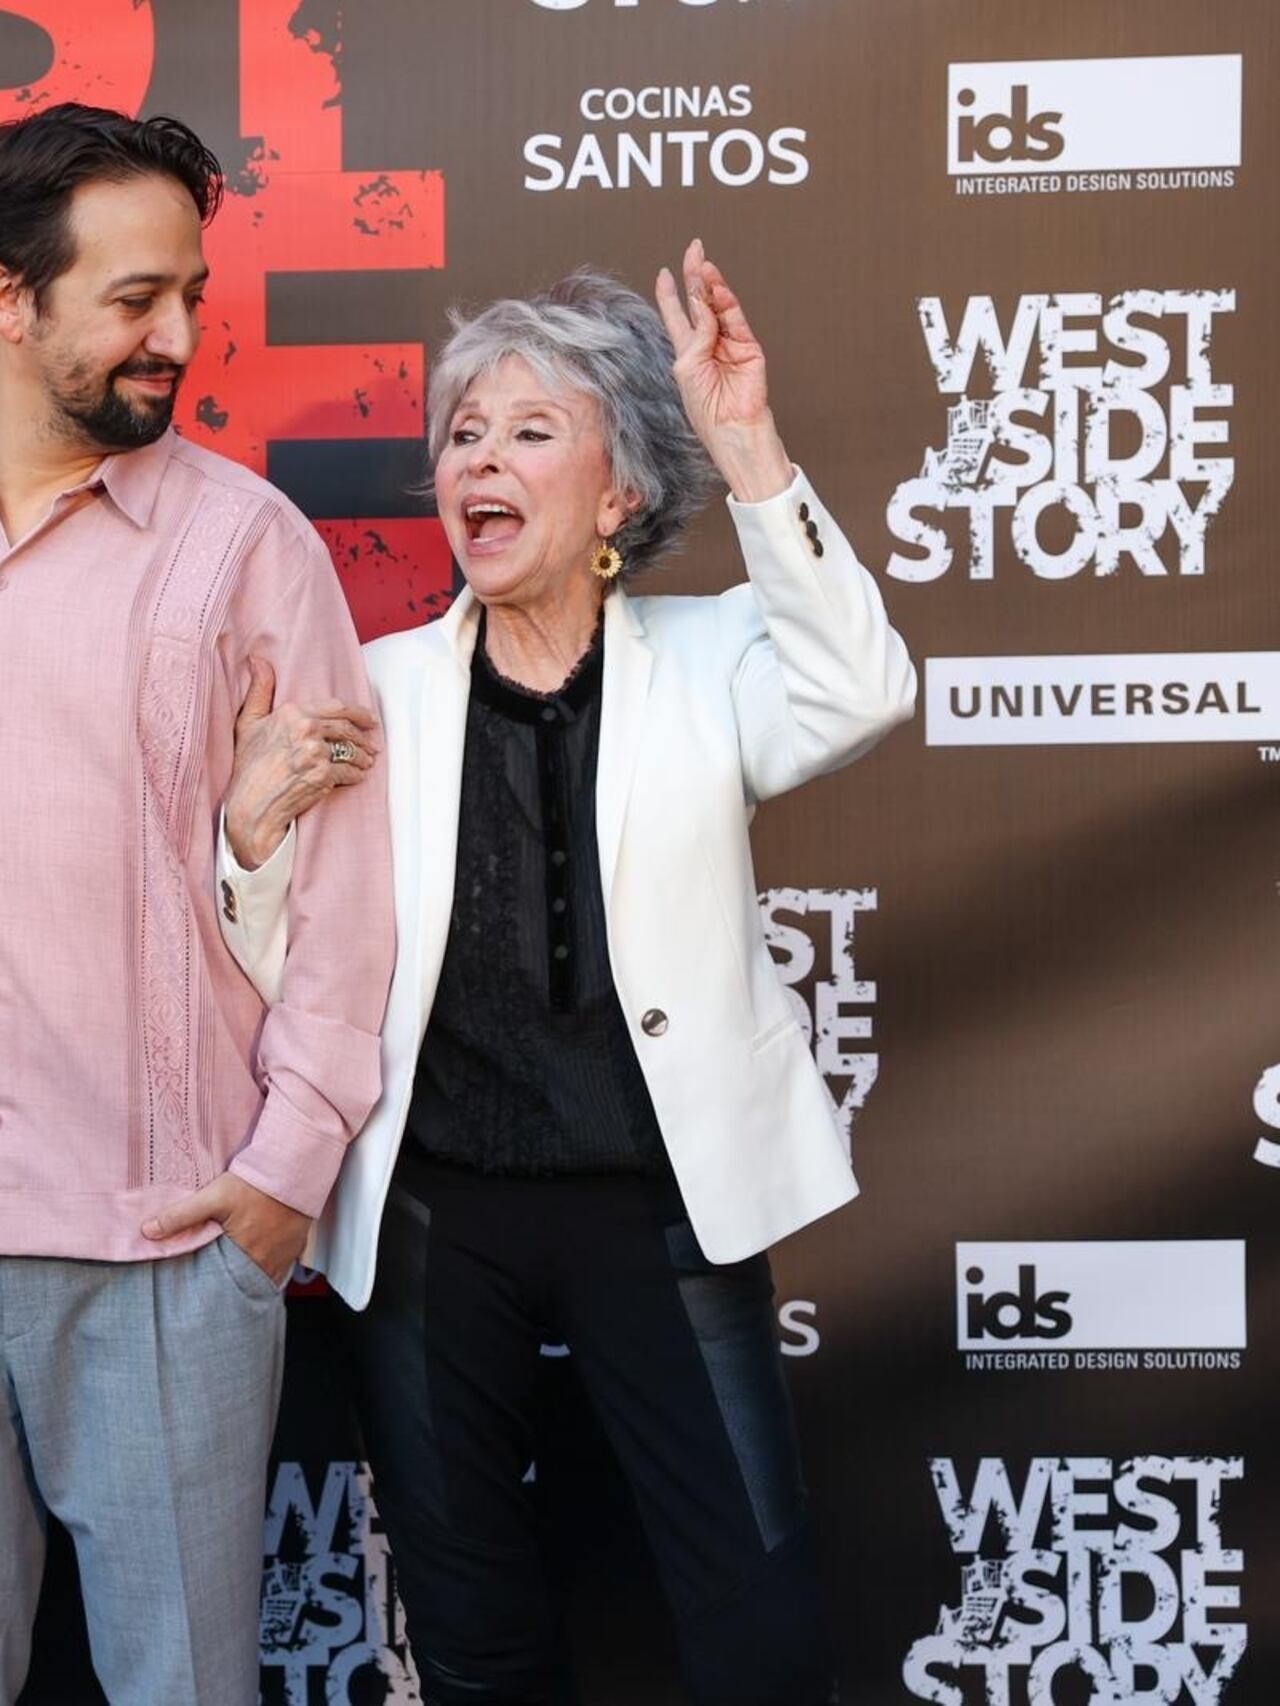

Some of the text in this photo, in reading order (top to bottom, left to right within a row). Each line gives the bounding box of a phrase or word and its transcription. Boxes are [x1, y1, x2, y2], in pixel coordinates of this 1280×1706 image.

[580, 84, 752, 120] COCINAS
[957, 84, 1065, 163] ids
[523, 127, 810, 191] SANTOS
[955, 169, 1235, 195] INTEGRATED DESIGN SOLUTIONS
[916, 288, 1236, 393] WEST
[985, 384, 1235, 488] SIDE
[885, 476, 1236, 583] STORY
[949, 681, 1262, 719] UNIVERSAL
[965, 1264, 1073, 1341] ids
[965, 1352, 1241, 1371] INTEGRATED DESIGN SOLUTIONS
[925, 1455, 1245, 1553] WEST
[999, 1549, 1246, 1648] SIDE
